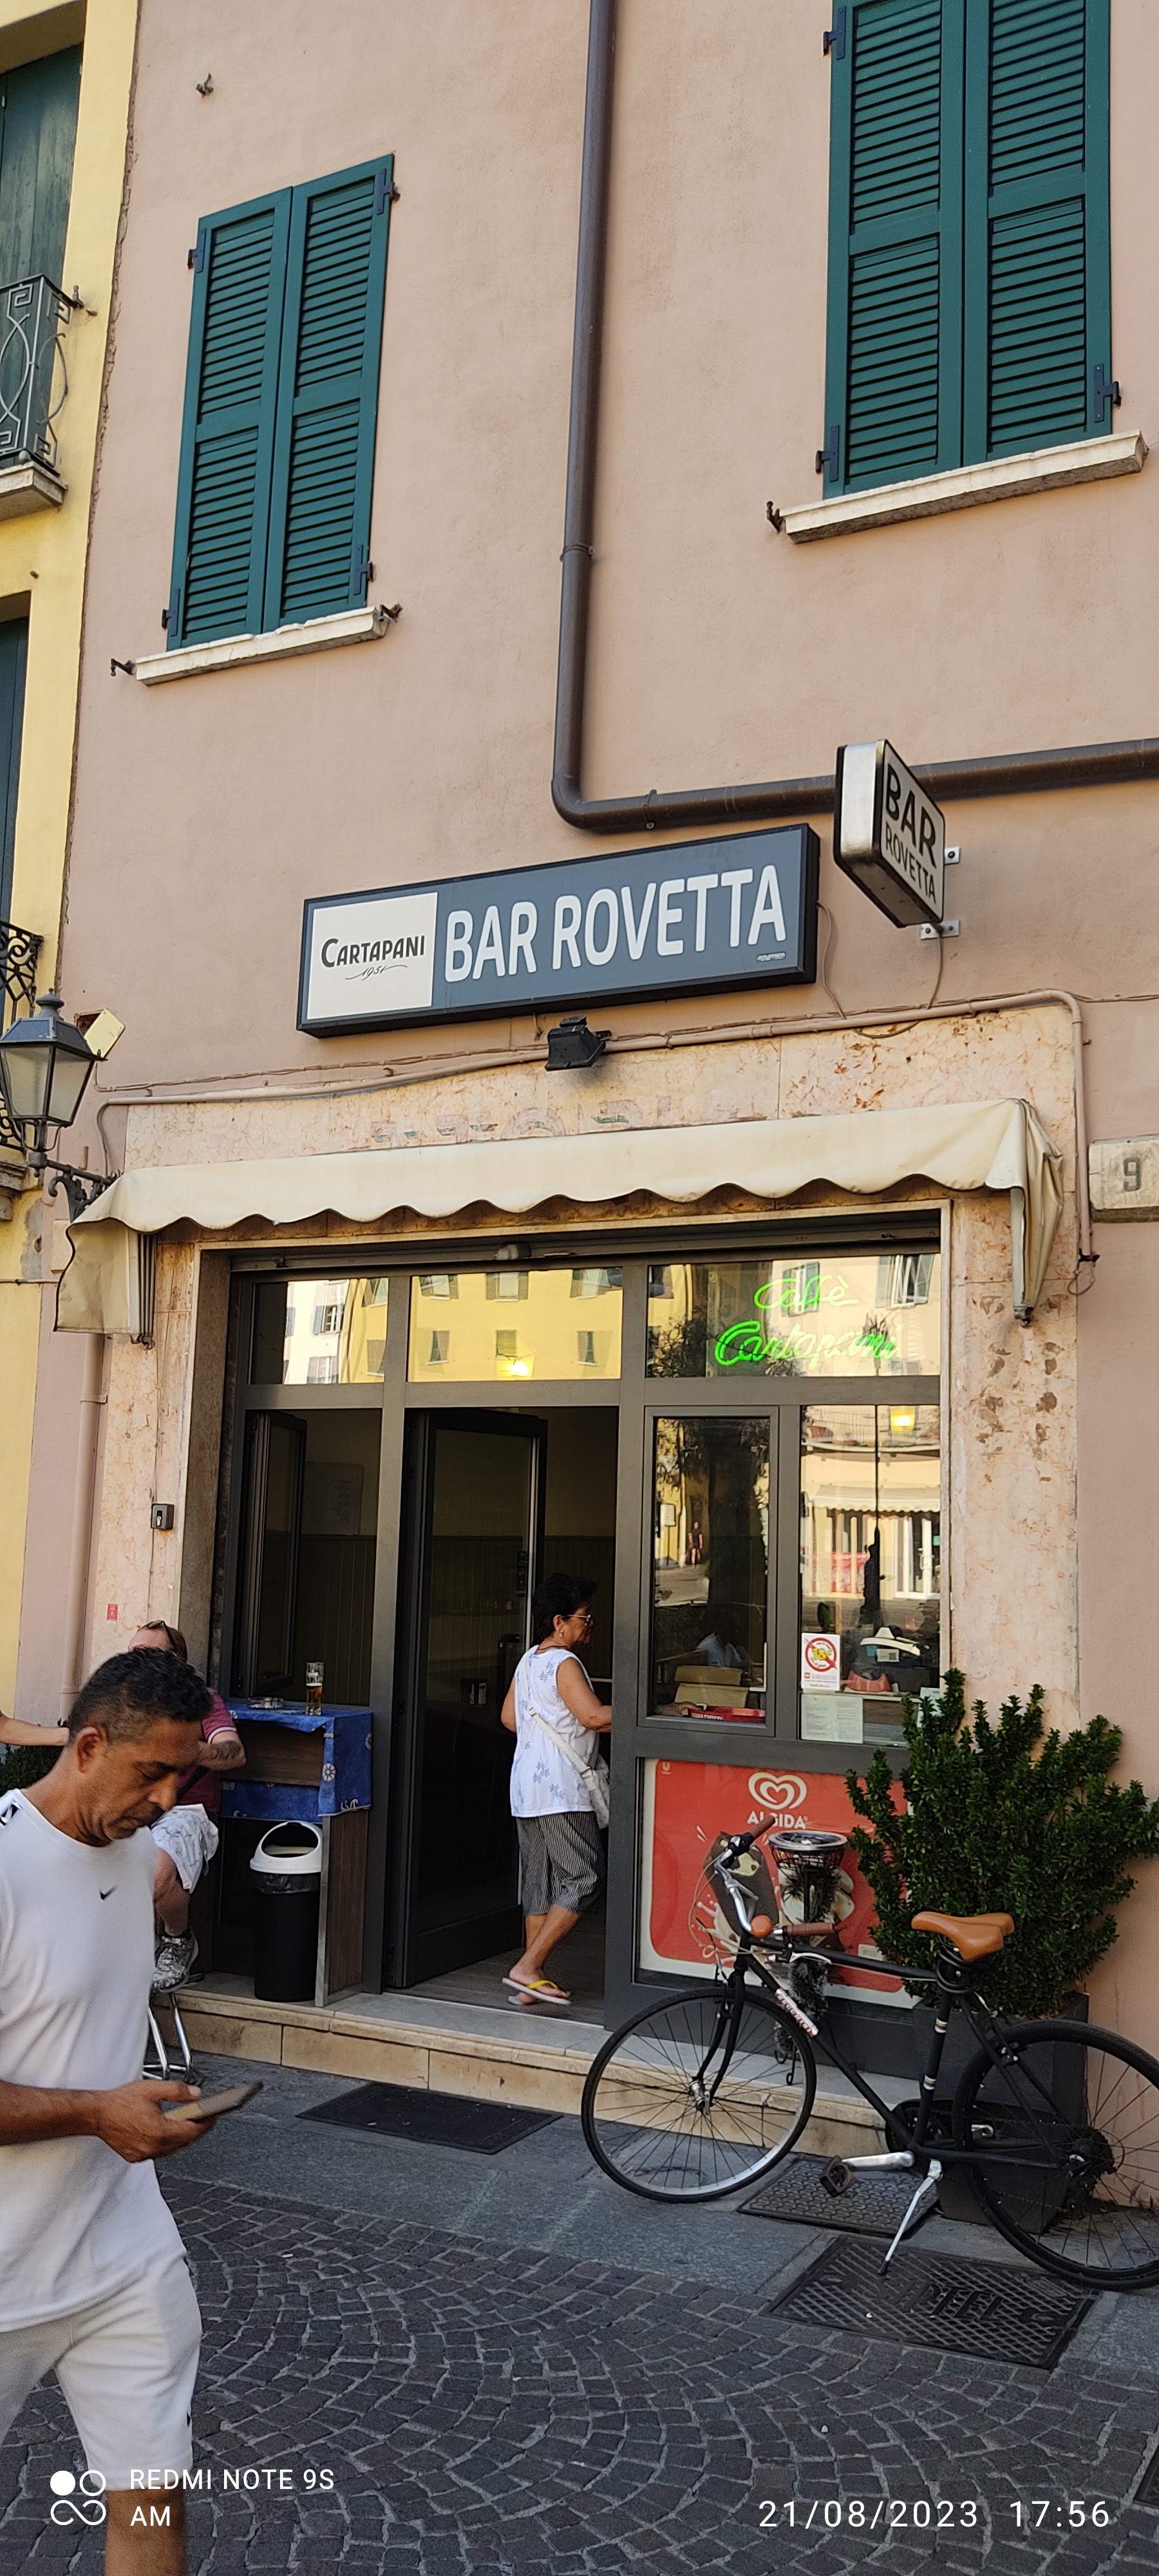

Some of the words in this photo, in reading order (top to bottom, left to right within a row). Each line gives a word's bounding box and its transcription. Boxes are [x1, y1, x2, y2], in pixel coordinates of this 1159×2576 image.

[886, 763, 936, 869] BAR
[885, 822, 936, 904] ROVETTA
[444, 902, 538, 983] BAR
[552, 864, 786, 971] ROVETTA
[321, 935, 425, 968] CARTAPANI
[361, 965, 388, 981] 1951
[1123, 1157, 1142, 1192] 9
[753, 1274, 860, 1310] Caffè
[714, 1320, 905, 1370] Cartapani
